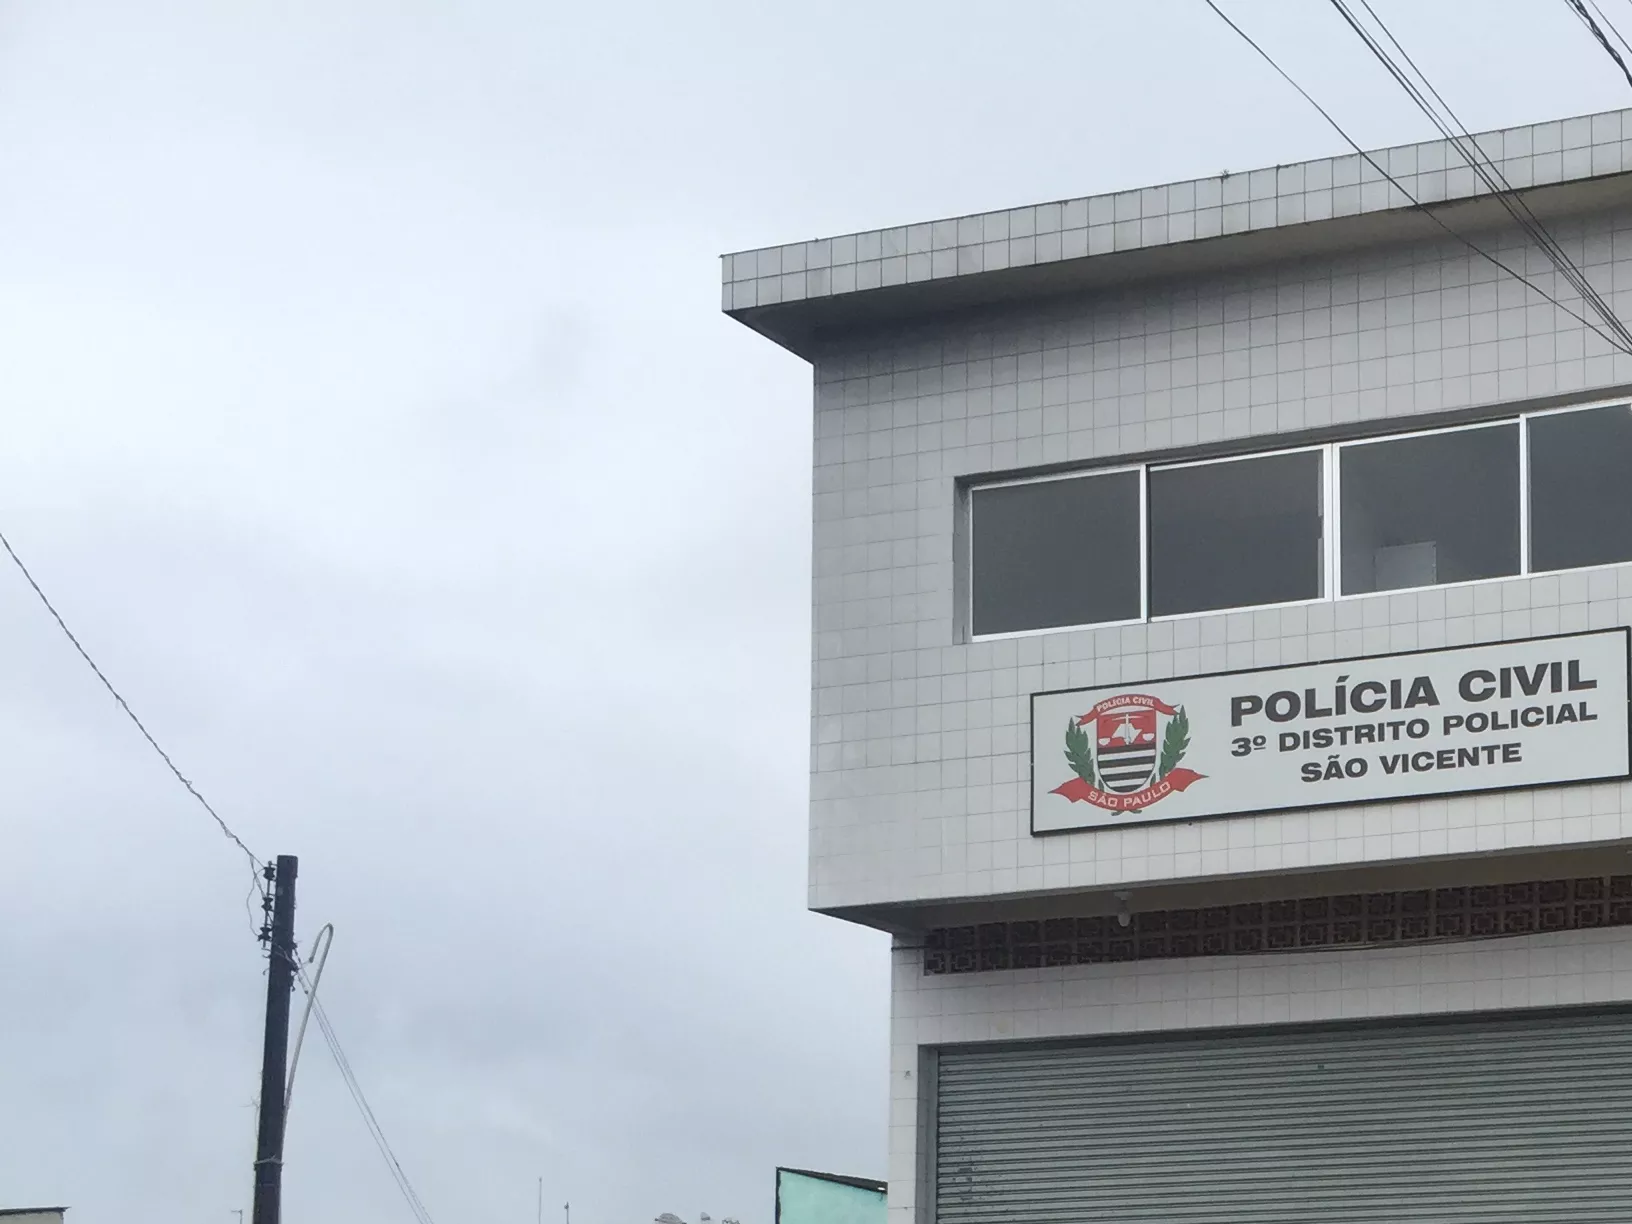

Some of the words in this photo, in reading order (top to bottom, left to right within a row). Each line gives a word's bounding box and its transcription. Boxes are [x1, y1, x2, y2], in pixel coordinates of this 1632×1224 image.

[1132, 696, 1154, 707] CIVIL
[1230, 674, 1440, 727] POLÍCIA
[1458, 658, 1598, 702] CIVIL
[1279, 718, 1430, 753] DISTRITO
[1443, 700, 1598, 737] POLICIAL
[1300, 754, 1368, 783] SÃO
[1382, 743, 1523, 775] VICENTE
[1123, 781, 1171, 807] PAULO
